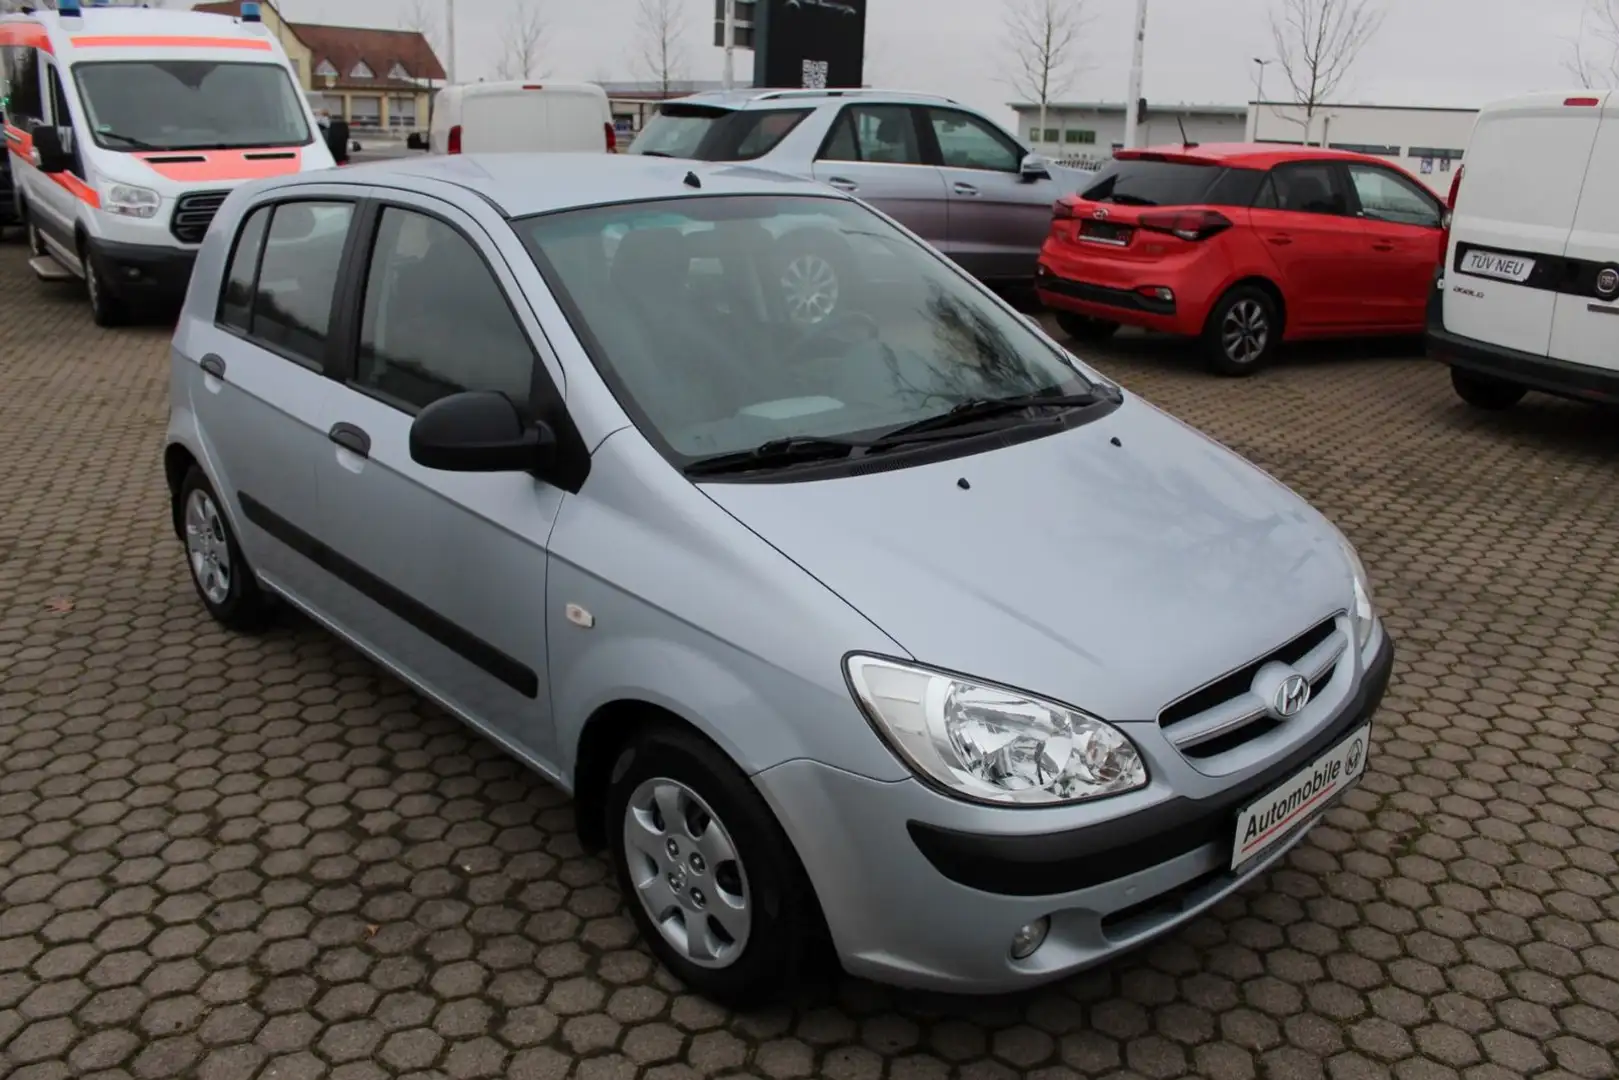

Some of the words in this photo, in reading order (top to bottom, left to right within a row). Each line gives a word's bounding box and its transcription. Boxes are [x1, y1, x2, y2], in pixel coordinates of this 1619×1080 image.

[1471, 252, 1495, 269] TÜV
[1494, 259, 1525, 276] NEU
[1243, 759, 1341, 844] Automobile
